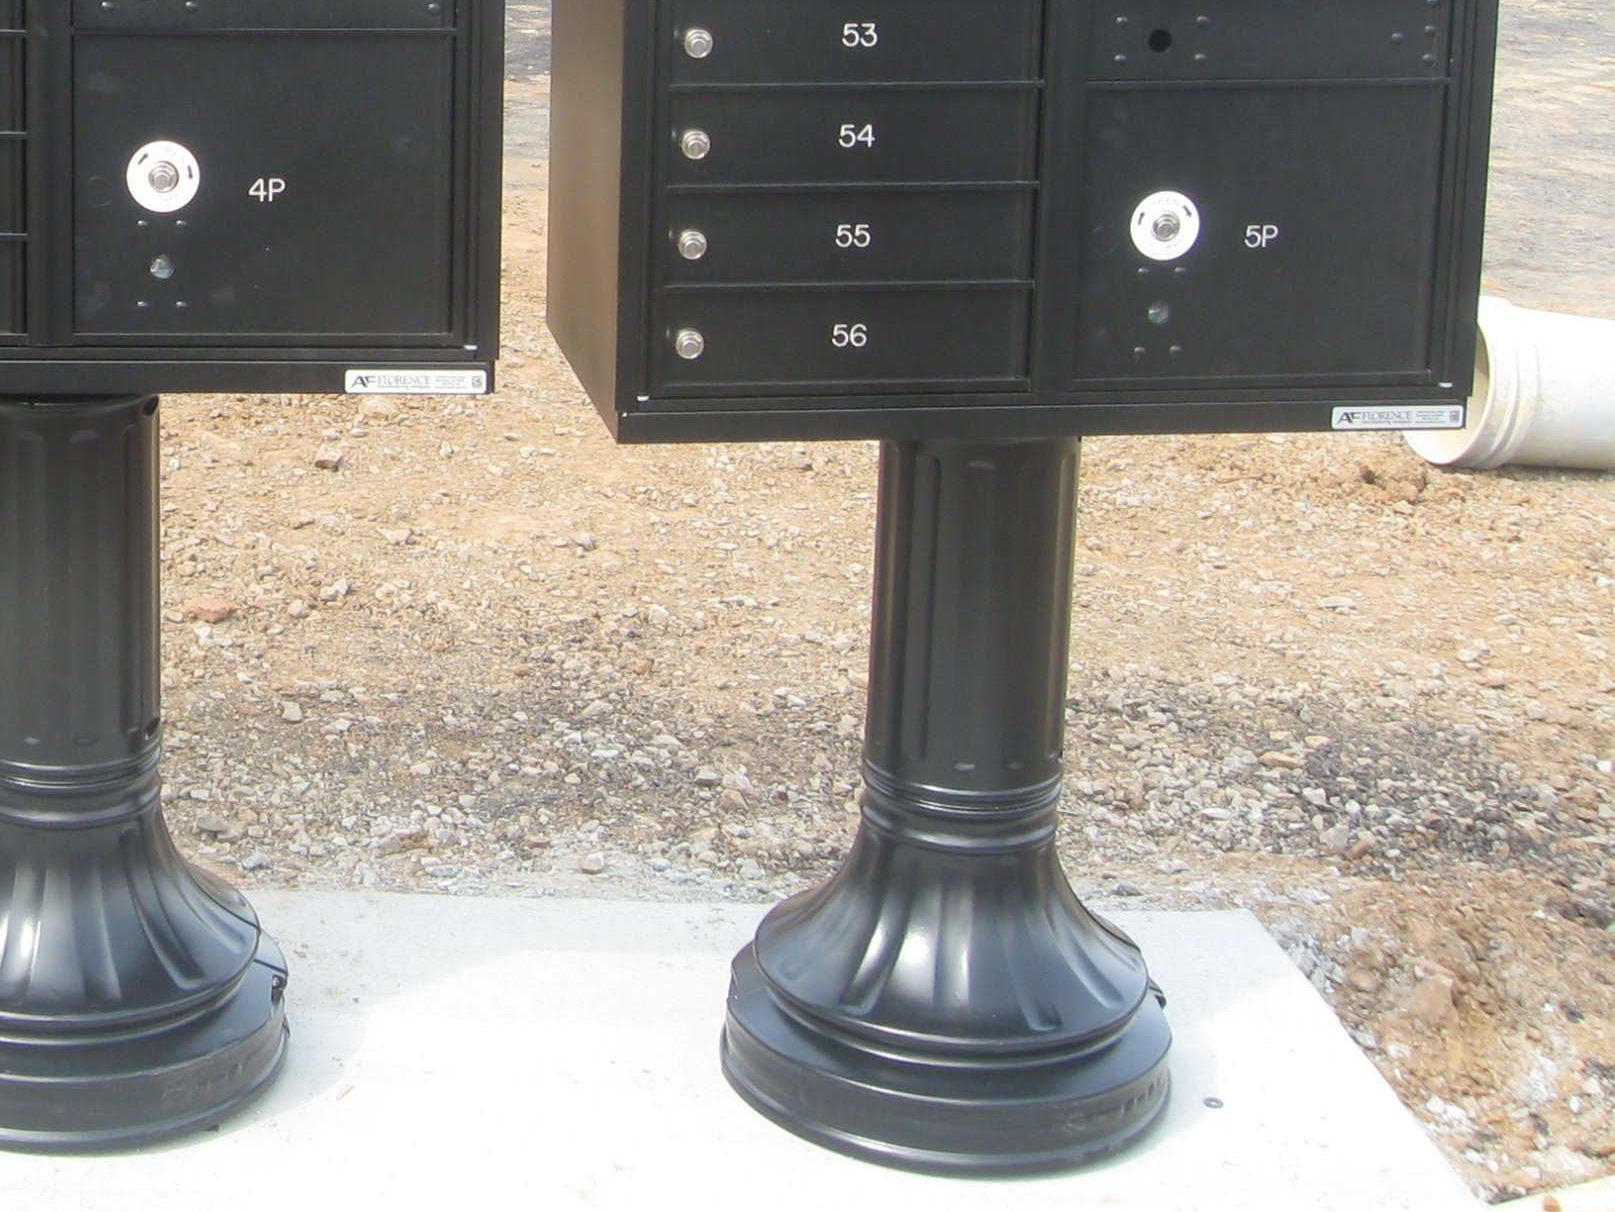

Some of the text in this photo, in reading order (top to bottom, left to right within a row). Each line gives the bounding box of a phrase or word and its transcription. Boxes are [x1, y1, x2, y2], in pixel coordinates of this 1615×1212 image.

[841, 22, 878, 48] 53
[838, 123, 876, 148] 54
[248, 177, 286, 203] 4P
[835, 224, 871, 248] 55
[1244, 224, 1279, 249] 5P
[831, 323, 868, 348] 56
[377, 375, 431, 386] FLORENCE
[1362, 410, 1412, 421] FLORENCE
